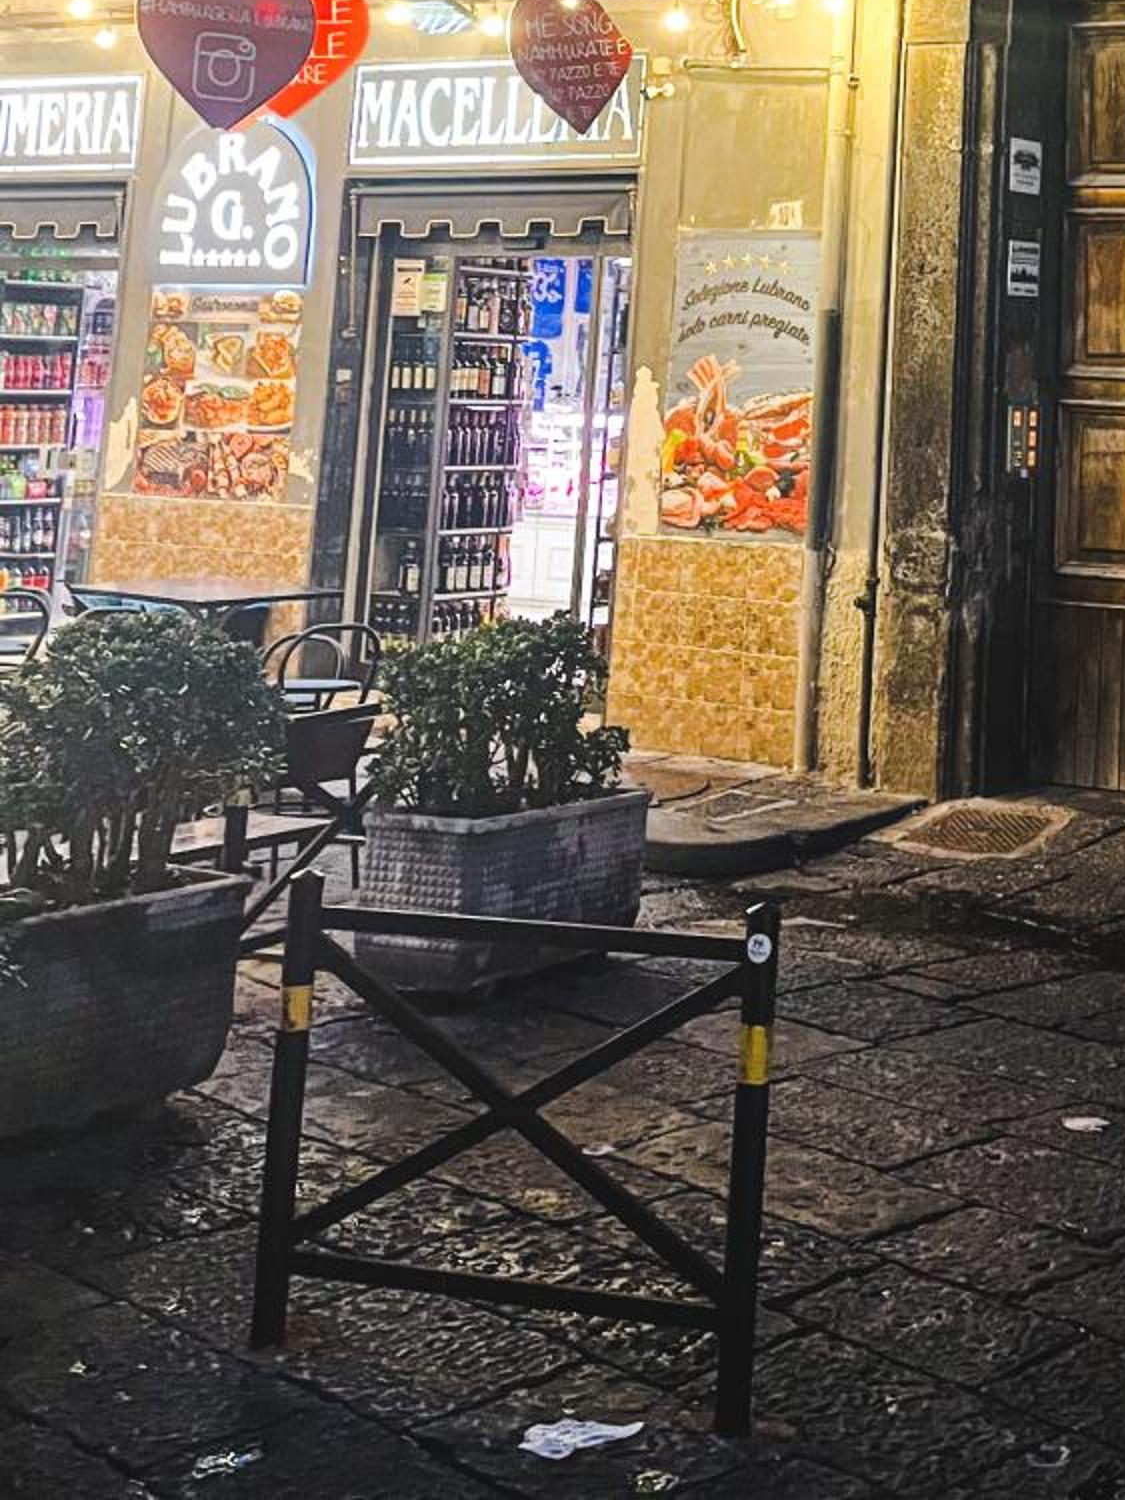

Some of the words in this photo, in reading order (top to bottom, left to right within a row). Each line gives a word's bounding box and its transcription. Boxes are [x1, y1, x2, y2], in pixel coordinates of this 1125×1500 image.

[0, 90, 131, 157] MERIA
[357, 76, 633, 149] MACELLA
[160, 132, 299, 270] LUBRANO
[709, 311, 749, 329] carni
[752, 276, 811, 311] Lubrano
